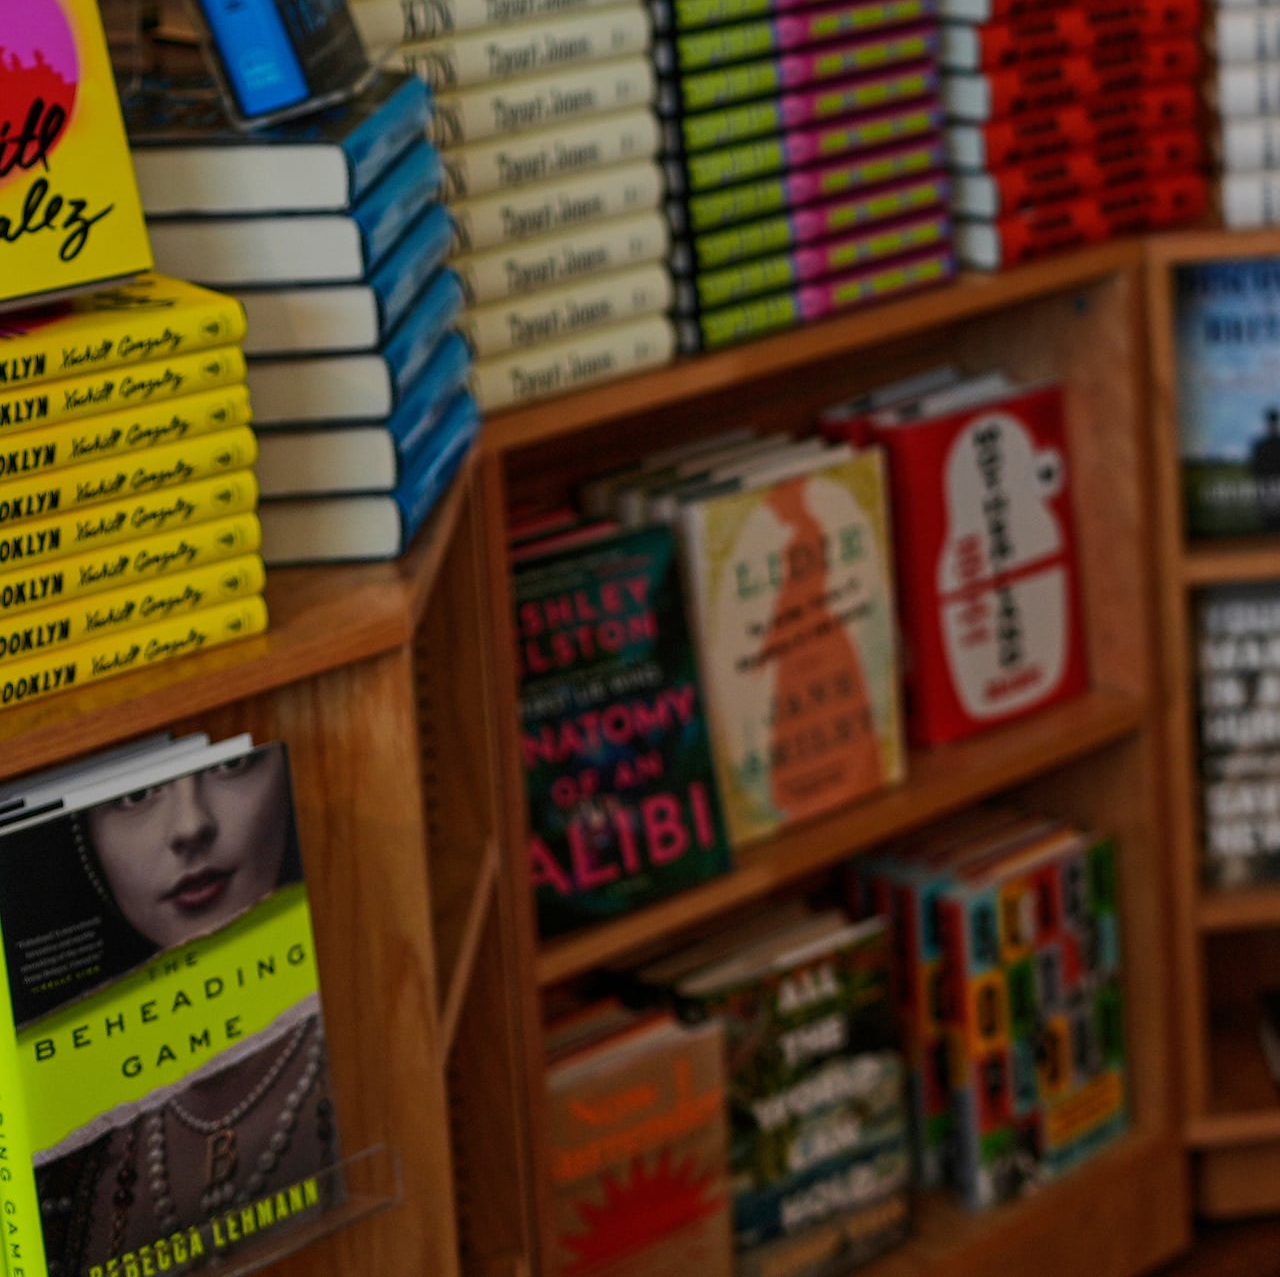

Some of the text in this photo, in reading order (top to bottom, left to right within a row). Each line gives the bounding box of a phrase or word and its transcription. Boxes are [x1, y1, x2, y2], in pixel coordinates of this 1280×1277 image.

[519, 578, 650, 636] SHLEY
[519, 610, 658, 673] LSTON
[522, 682, 697, 767] NATOMY
[149, 950, 199, 982] THE
[34, 943, 306, 1062] BEHEADING
[121, 1015, 243, 1079] GAME
[212, 1176, 320, 1248] LEHMANN
